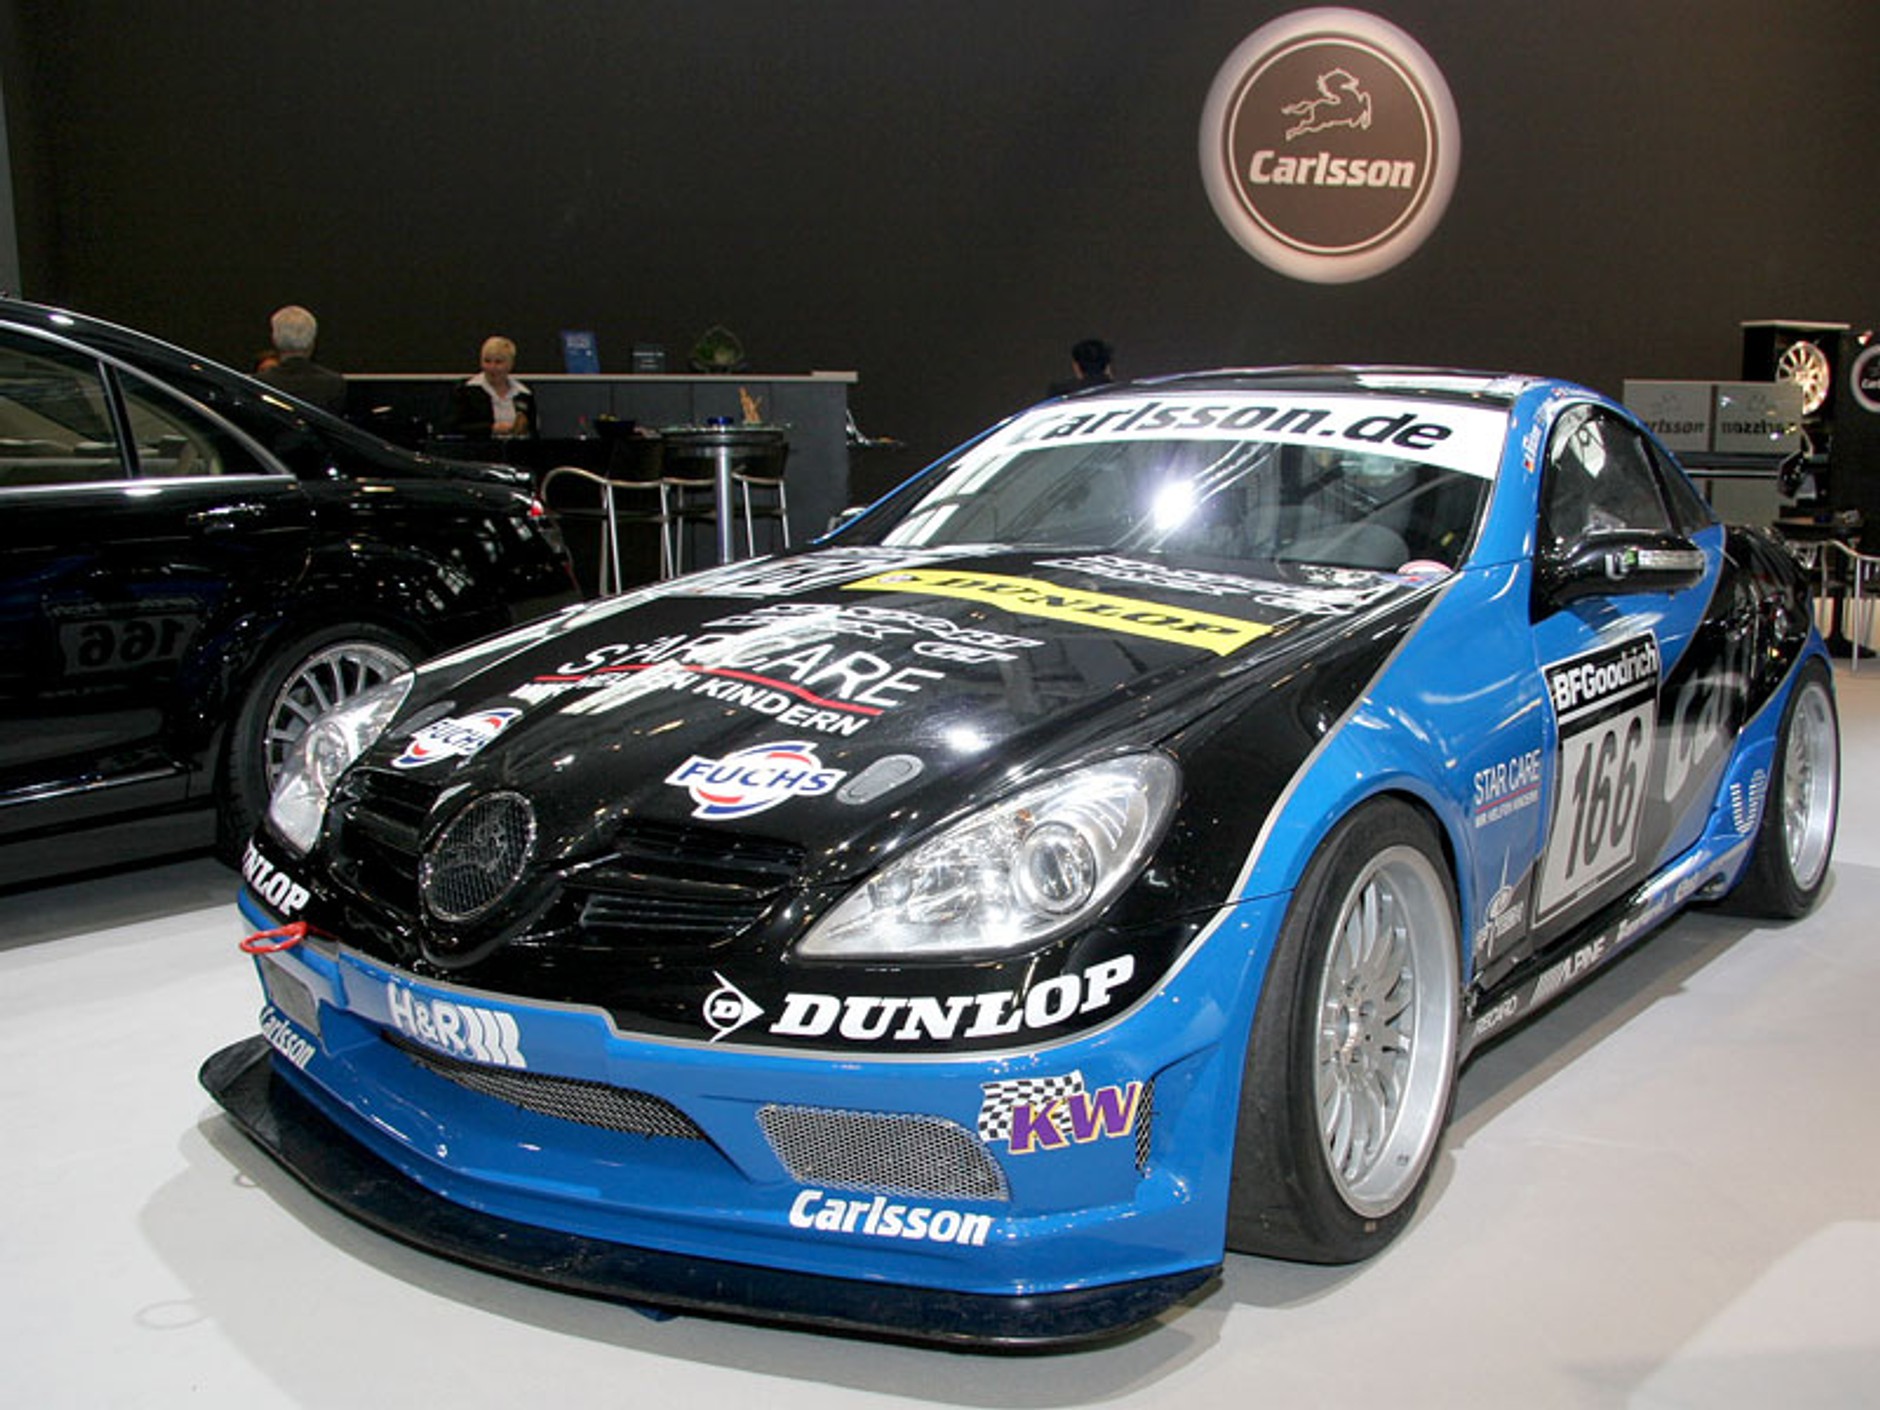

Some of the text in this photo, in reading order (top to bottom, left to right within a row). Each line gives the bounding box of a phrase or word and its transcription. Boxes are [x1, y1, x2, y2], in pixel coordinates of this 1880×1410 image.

[1250, 150, 1415, 188] Carlsson
[932, 577, 1239, 635] DUNLOP
[708, 636, 946, 707] CARE
[1553, 642, 1658, 711] BFGoodrich
[693, 676, 870, 737] KINDERN
[677, 758, 839, 794] FUCHS
[1474, 748, 1541, 806] STAR CARE
[1564, 716, 1642, 880] 166
[388, 982, 467, 1051] H&R
[769, 954, 1136, 1041] DUNLOP
[259, 1006, 316, 1071] Carlsson
[1009, 1081, 1141, 1155] KW
[788, 1188, 996, 1246] Carlsson
